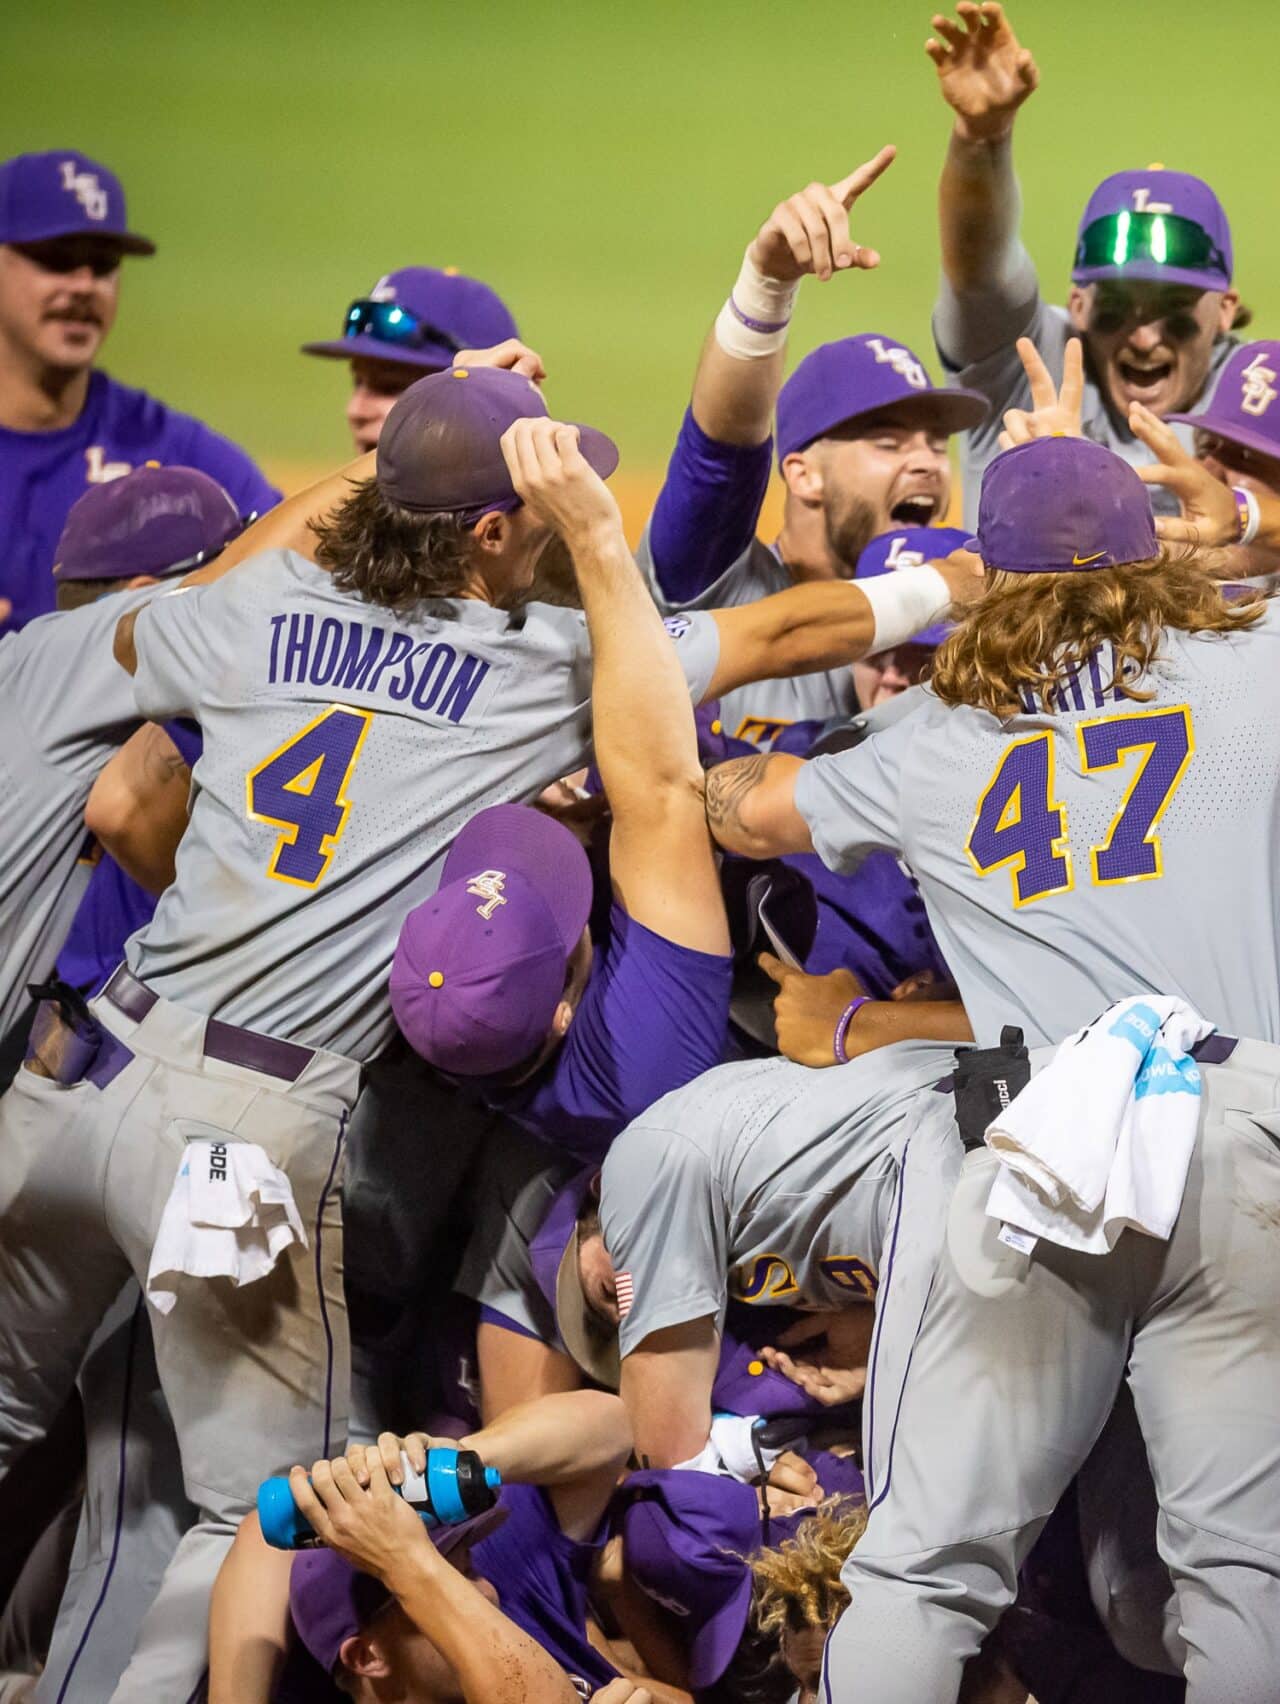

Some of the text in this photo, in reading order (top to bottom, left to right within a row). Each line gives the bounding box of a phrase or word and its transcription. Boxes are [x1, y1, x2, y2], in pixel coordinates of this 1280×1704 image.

[59, 160, 107, 220] LSU
[864, 339, 928, 390] LSU
[1241, 353, 1278, 417] LSU
[267, 613, 490, 726] THOMPSON
[246, 703, 376, 889] 4
[963, 703, 1196, 909] 47
